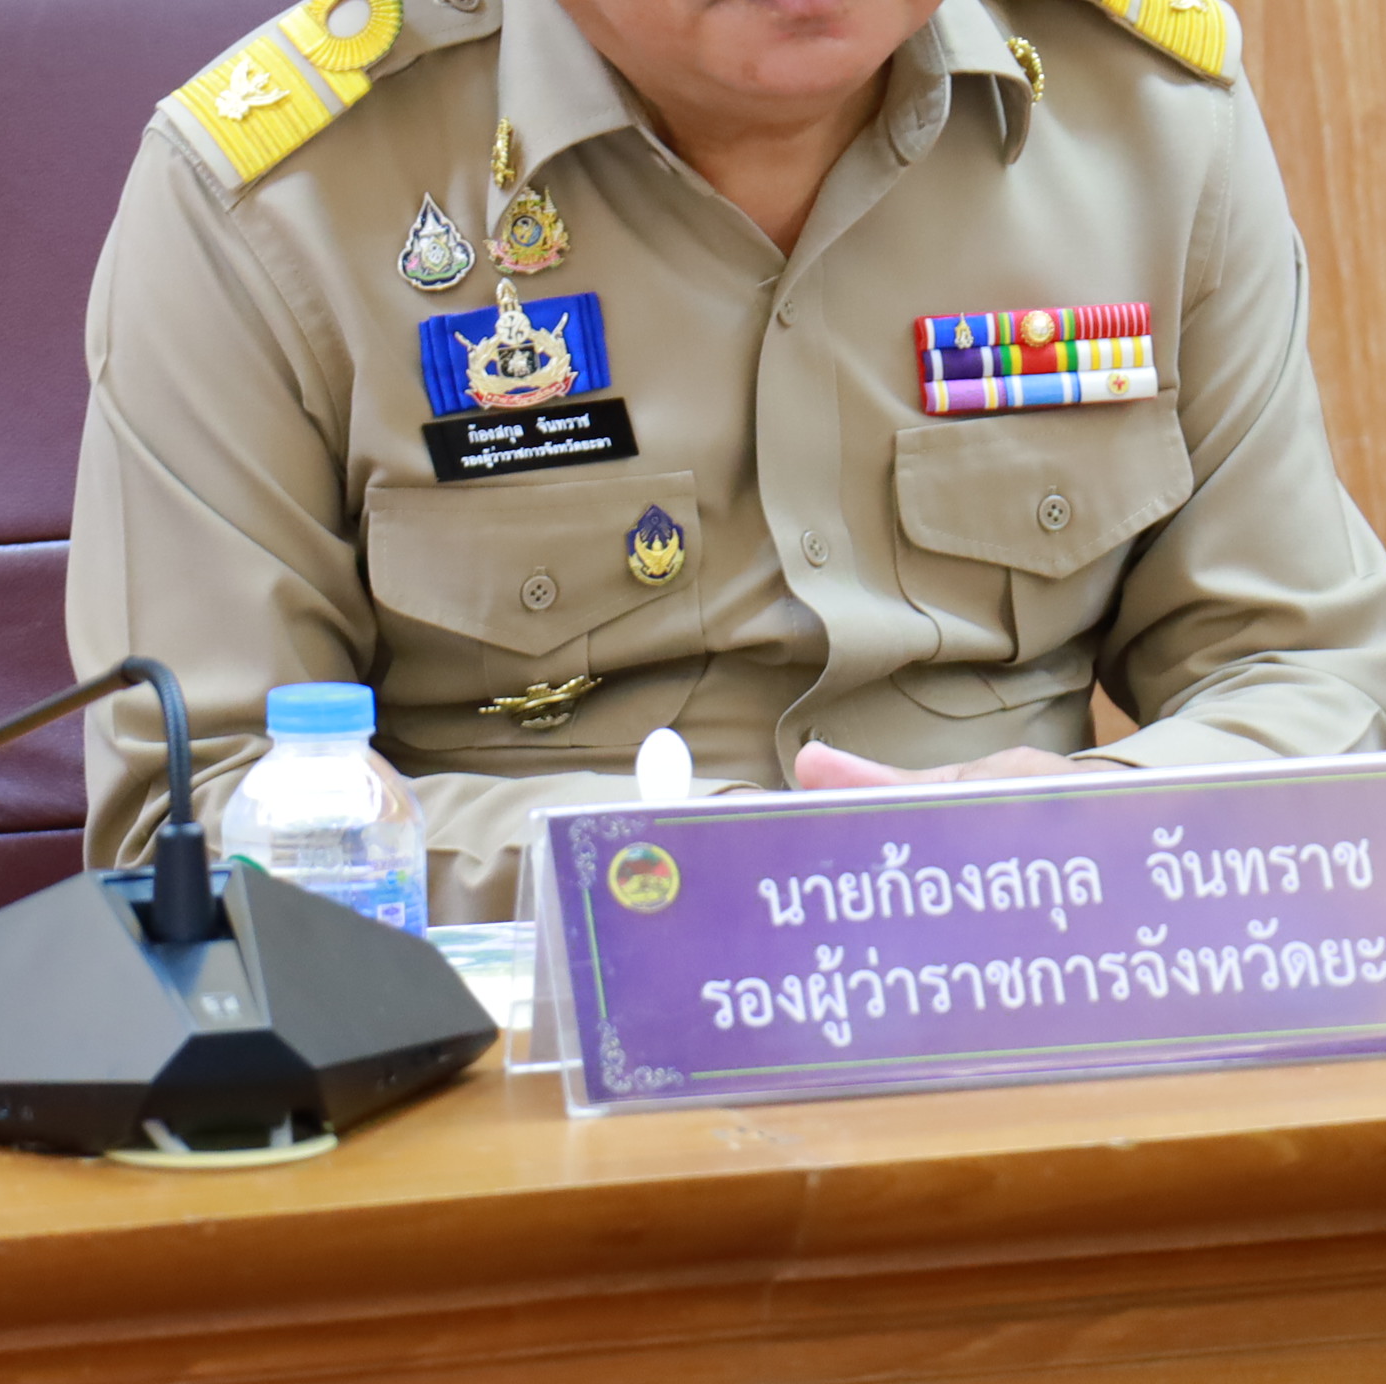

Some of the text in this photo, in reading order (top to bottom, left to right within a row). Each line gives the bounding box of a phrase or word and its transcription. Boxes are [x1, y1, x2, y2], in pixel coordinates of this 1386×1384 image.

[758, 824, 1374, 932] นายก้องสกุล จันทราช
